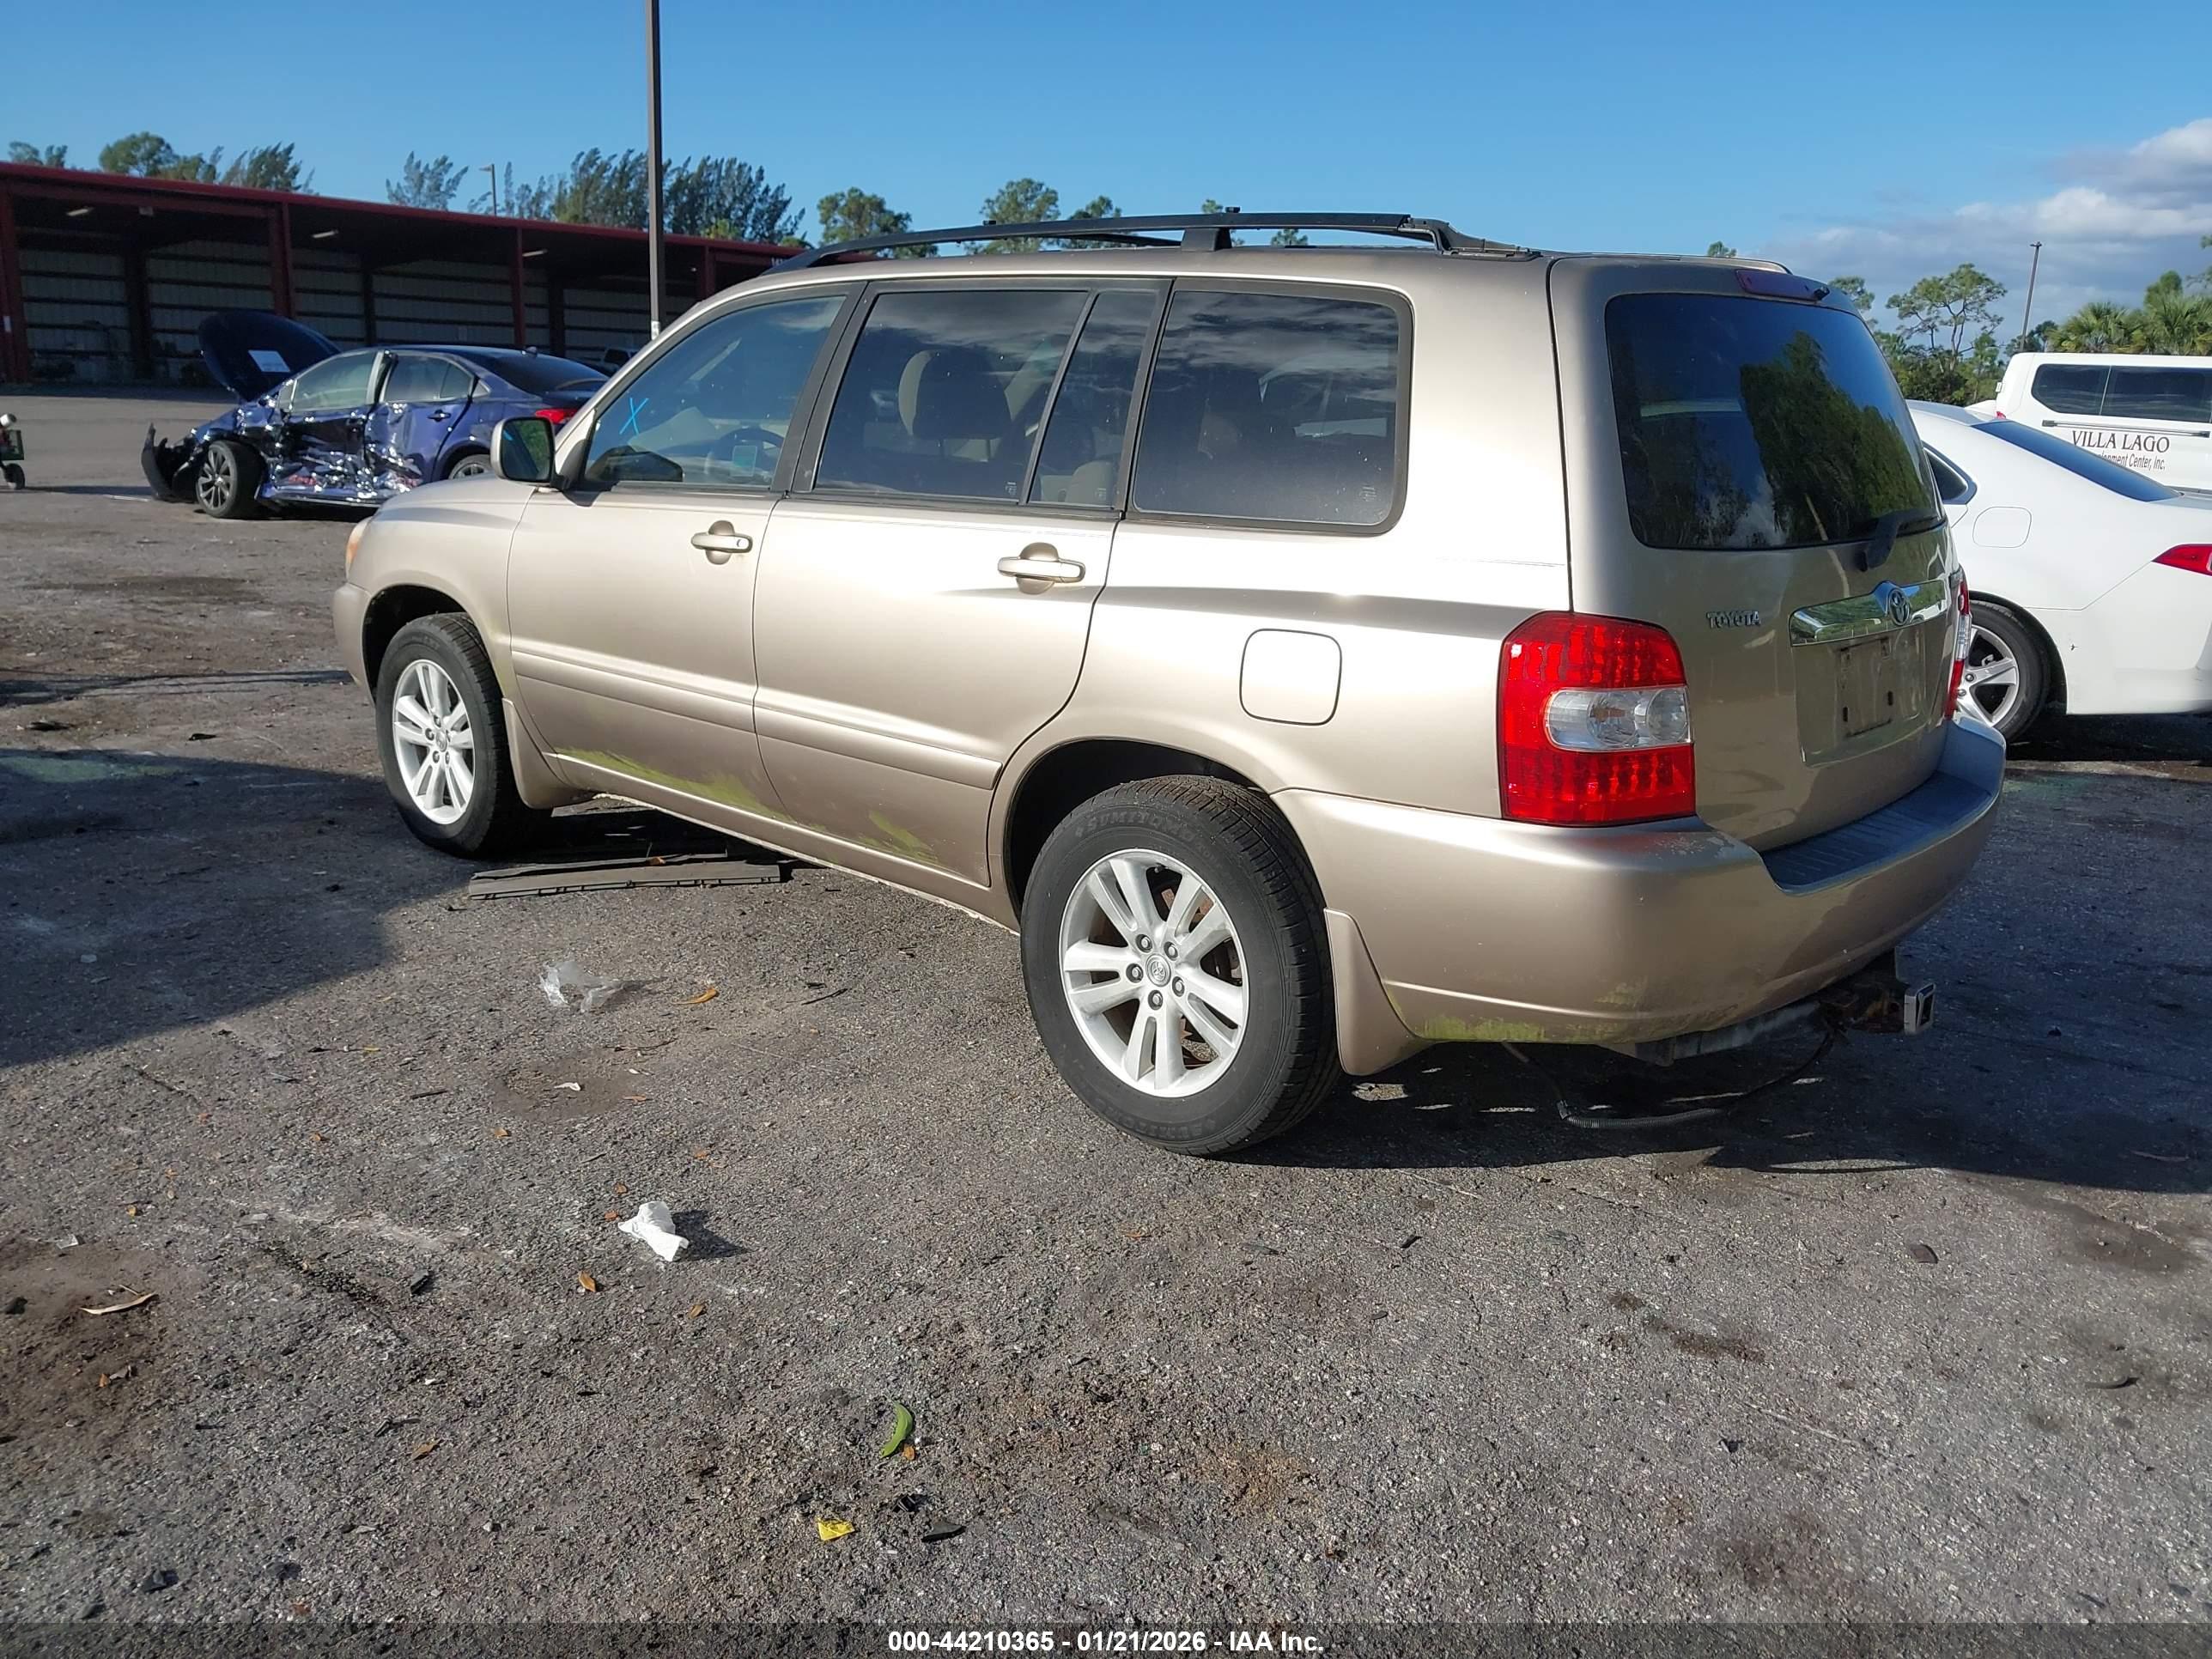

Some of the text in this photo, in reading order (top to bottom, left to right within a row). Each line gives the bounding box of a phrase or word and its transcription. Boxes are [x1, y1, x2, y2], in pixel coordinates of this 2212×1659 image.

[2072, 430, 2170, 453] VILLA LAGO
[2129, 453, 2152, 471] Center,
[2153, 456, 2166, 471] Inc.
[1706, 611, 1761, 629] TOYOTA
